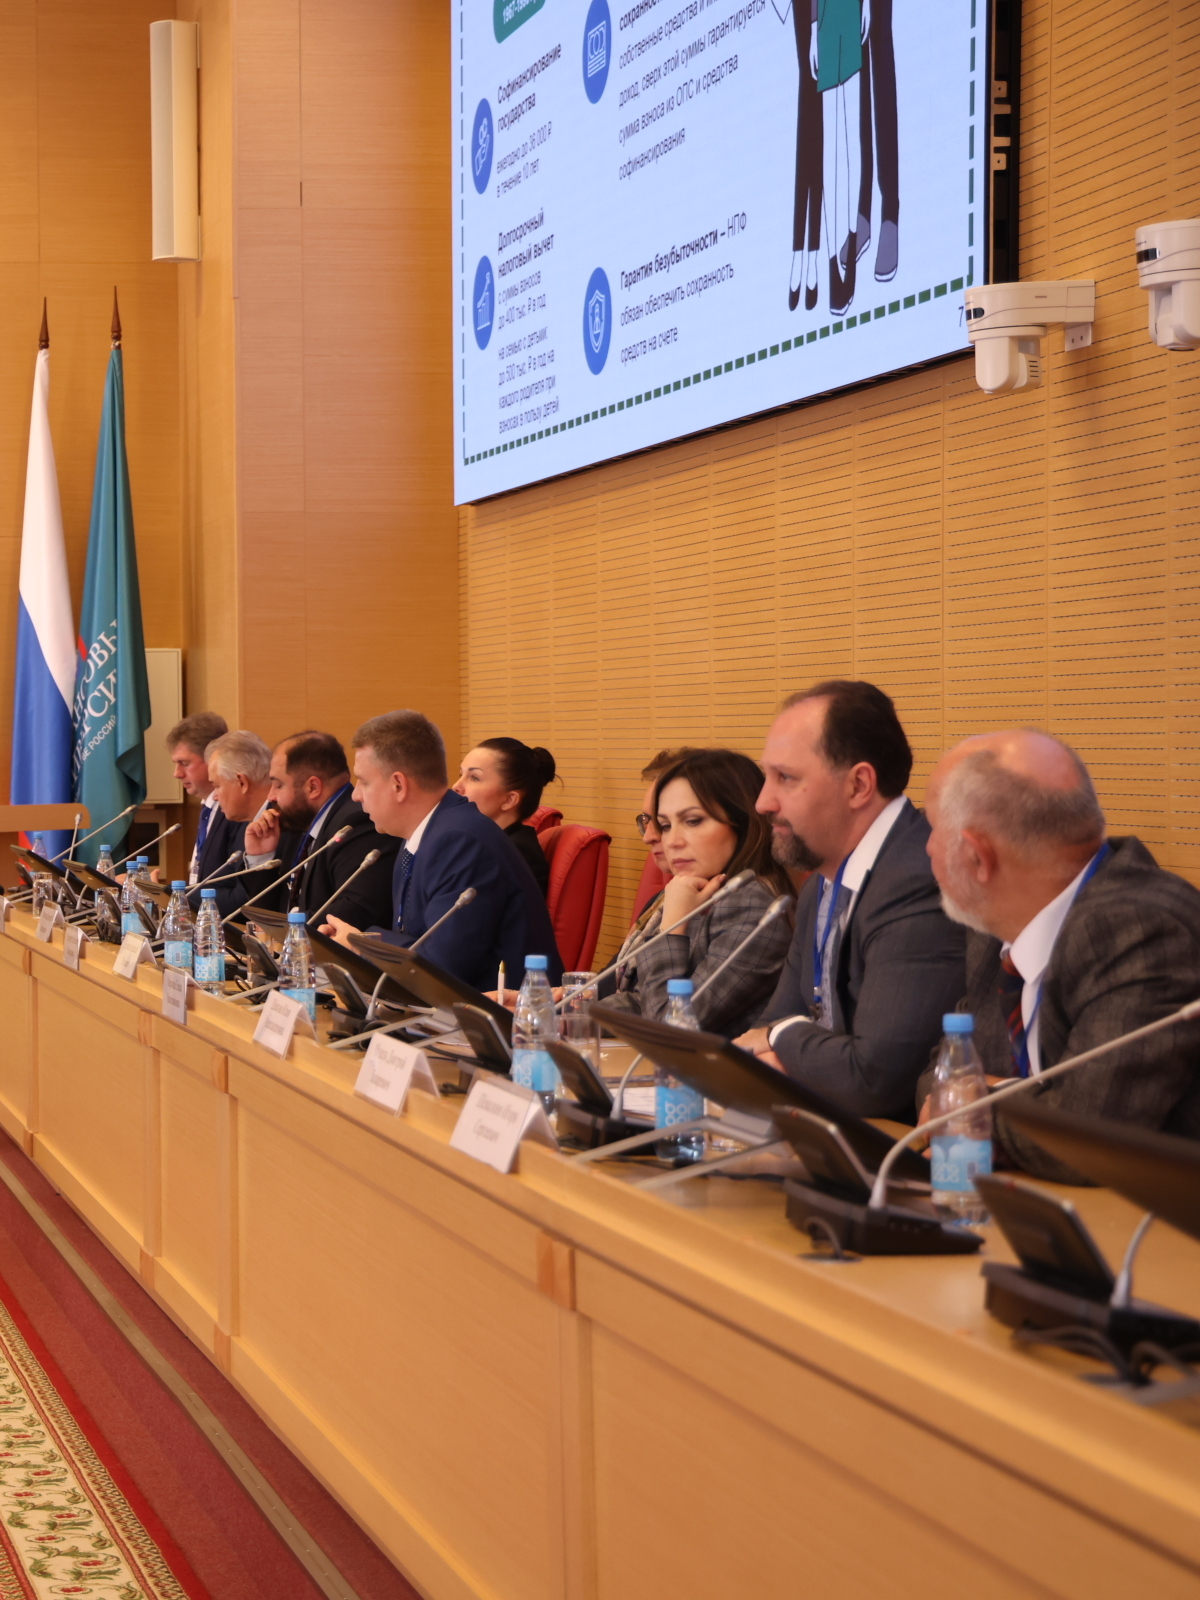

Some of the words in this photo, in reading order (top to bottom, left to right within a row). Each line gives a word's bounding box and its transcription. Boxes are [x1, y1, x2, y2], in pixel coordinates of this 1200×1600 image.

[619, 27, 663, 69] собственные
[664, 1, 698, 40] средства
[641, 65, 662, 90] сверх
[663, 49, 680, 76] этой
[681, 35, 706, 68] суммы
[707, 0, 766, 48] гарантируется
[498, 43, 562, 104] Софинансирование
[619, 118, 640, 147] сумма
[641, 102, 665, 130] взноса
[666, 96, 675, 114] из
[676, 79, 694, 107] ОПС
[695, 78, 701, 95] и
[702, 54, 738, 94] средства
[498, 92, 536, 133] государства
[619, 128, 686, 181] софинансирования
[498, 206, 544, 256] Долгосрочный
[498, 243, 532, 279] налоговый
[533, 233, 554, 260] вычет
[620, 261, 653, 292] Гарантия
[654, 229, 718, 273] безубыточности
[727, 211, 747, 238] НПФ
[620, 303, 644, 327] обязан
[645, 286, 685, 316] обеспечить
[686, 263, 735, 298] сохранность
[620, 339, 647, 367] средств
[648, 337, 657, 353] на
[658, 327, 678, 349] счете
